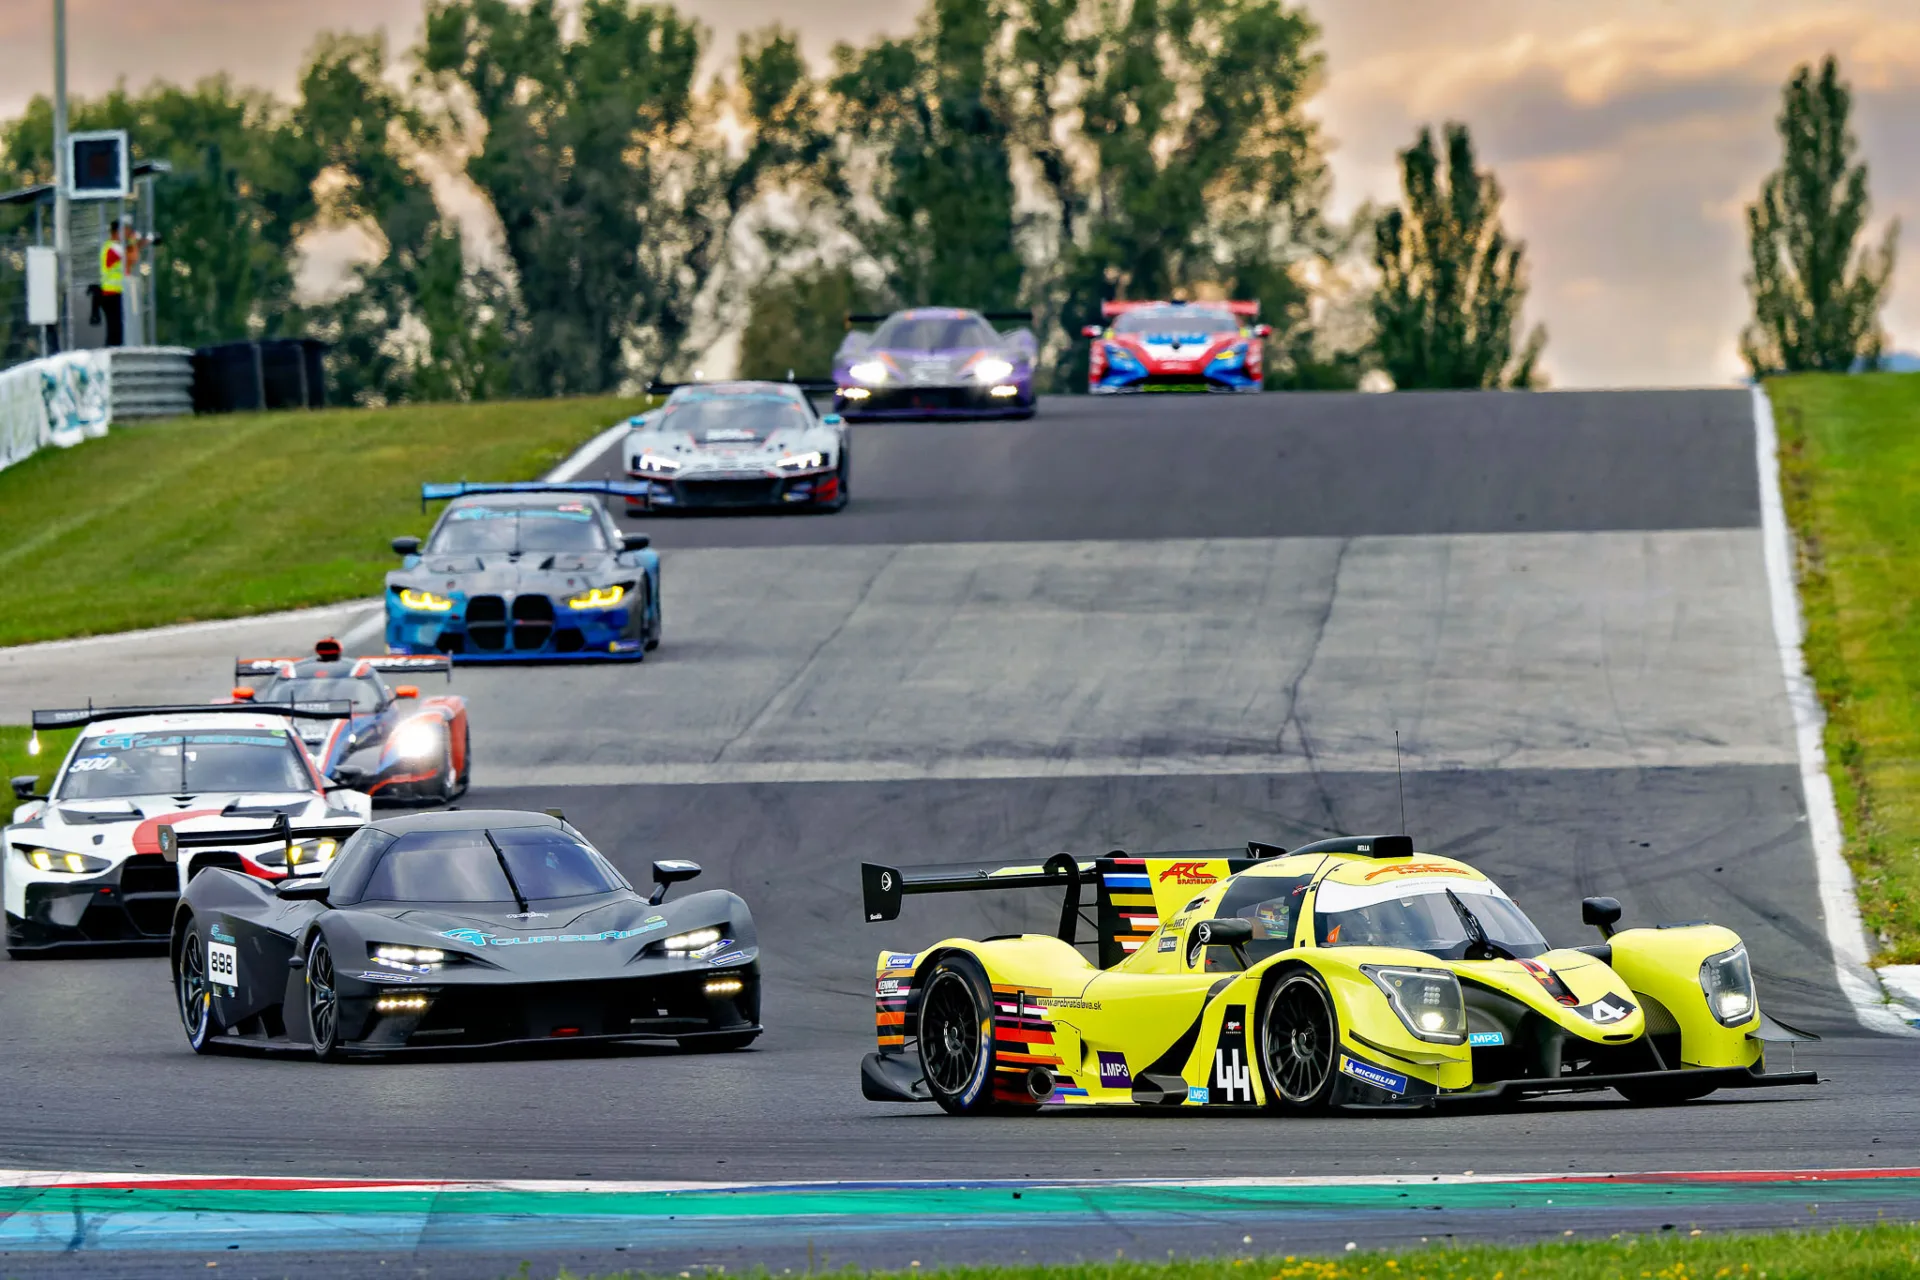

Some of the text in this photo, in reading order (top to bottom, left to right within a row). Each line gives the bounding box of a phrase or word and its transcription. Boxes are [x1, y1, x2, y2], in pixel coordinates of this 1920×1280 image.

[69, 756, 116, 773] 500
[558, 919, 668, 943] SERIES
[211, 951, 233, 975] 898
[1100, 1062, 1130, 1077] LMP3
[1215, 1048, 1251, 1102] 44
[1354, 1066, 1397, 1087] MICHELIN
[1190, 1089, 1207, 1100] LMP3
